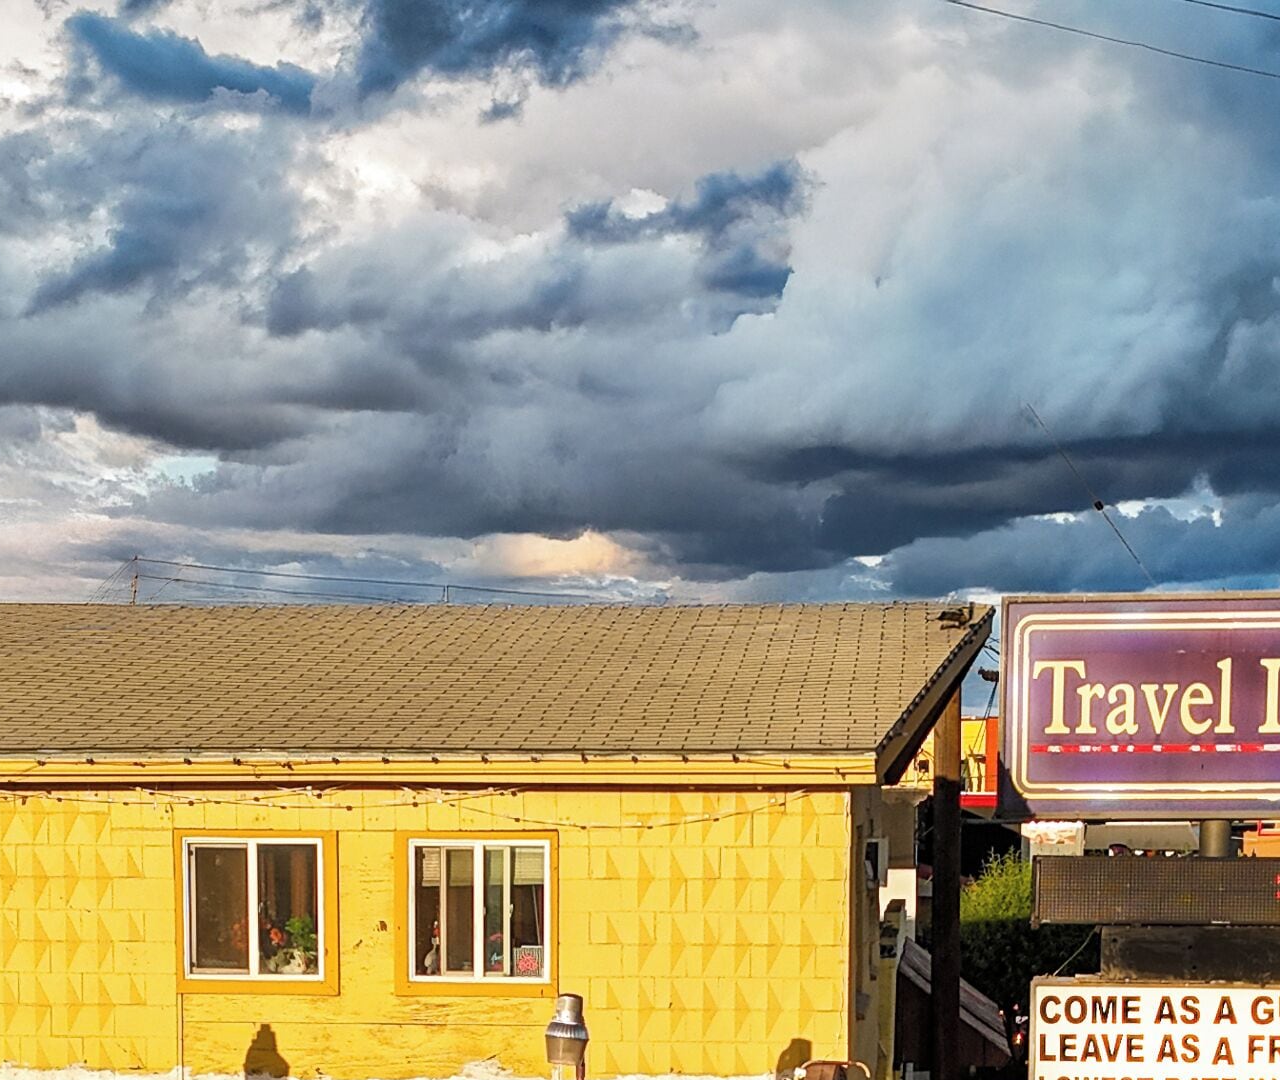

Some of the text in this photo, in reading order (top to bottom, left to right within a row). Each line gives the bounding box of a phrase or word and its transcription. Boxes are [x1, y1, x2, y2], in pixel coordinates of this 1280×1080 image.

[1033, 657, 1235, 735] Travel
[1039, 995, 1141, 1025] COME
[1154, 995, 1201, 1025] AS
[1213, 996, 1237, 1025] A
[1039, 1033, 1145, 1063] LEAVE
[1156, 1034, 1201, 1064] AS
[1211, 1037, 1235, 1066] A
